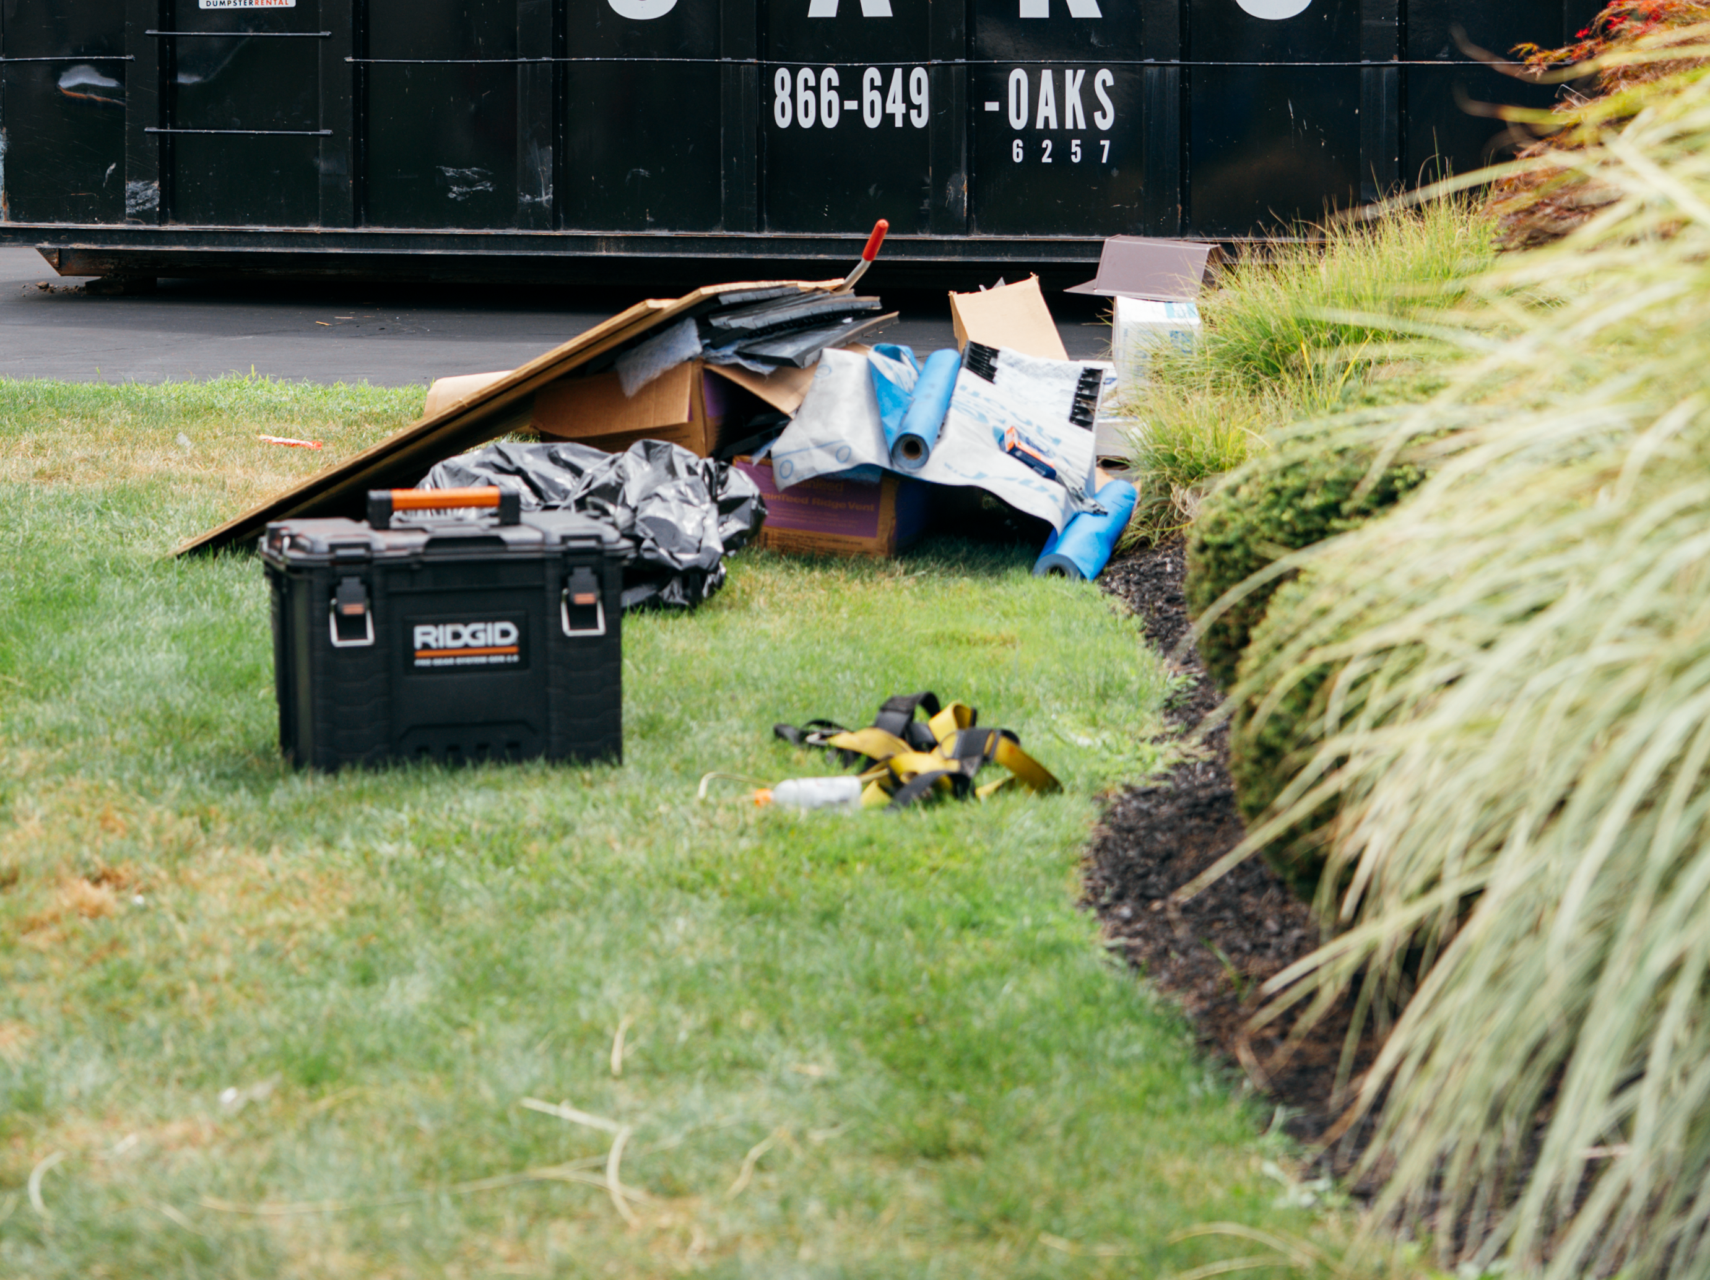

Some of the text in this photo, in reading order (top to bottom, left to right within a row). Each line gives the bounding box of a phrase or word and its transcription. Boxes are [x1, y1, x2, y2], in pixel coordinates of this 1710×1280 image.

[811, 496, 847, 510] Ridge
[847, 501, 876, 513] Vent
[413, 621, 519, 650] RIDGID
